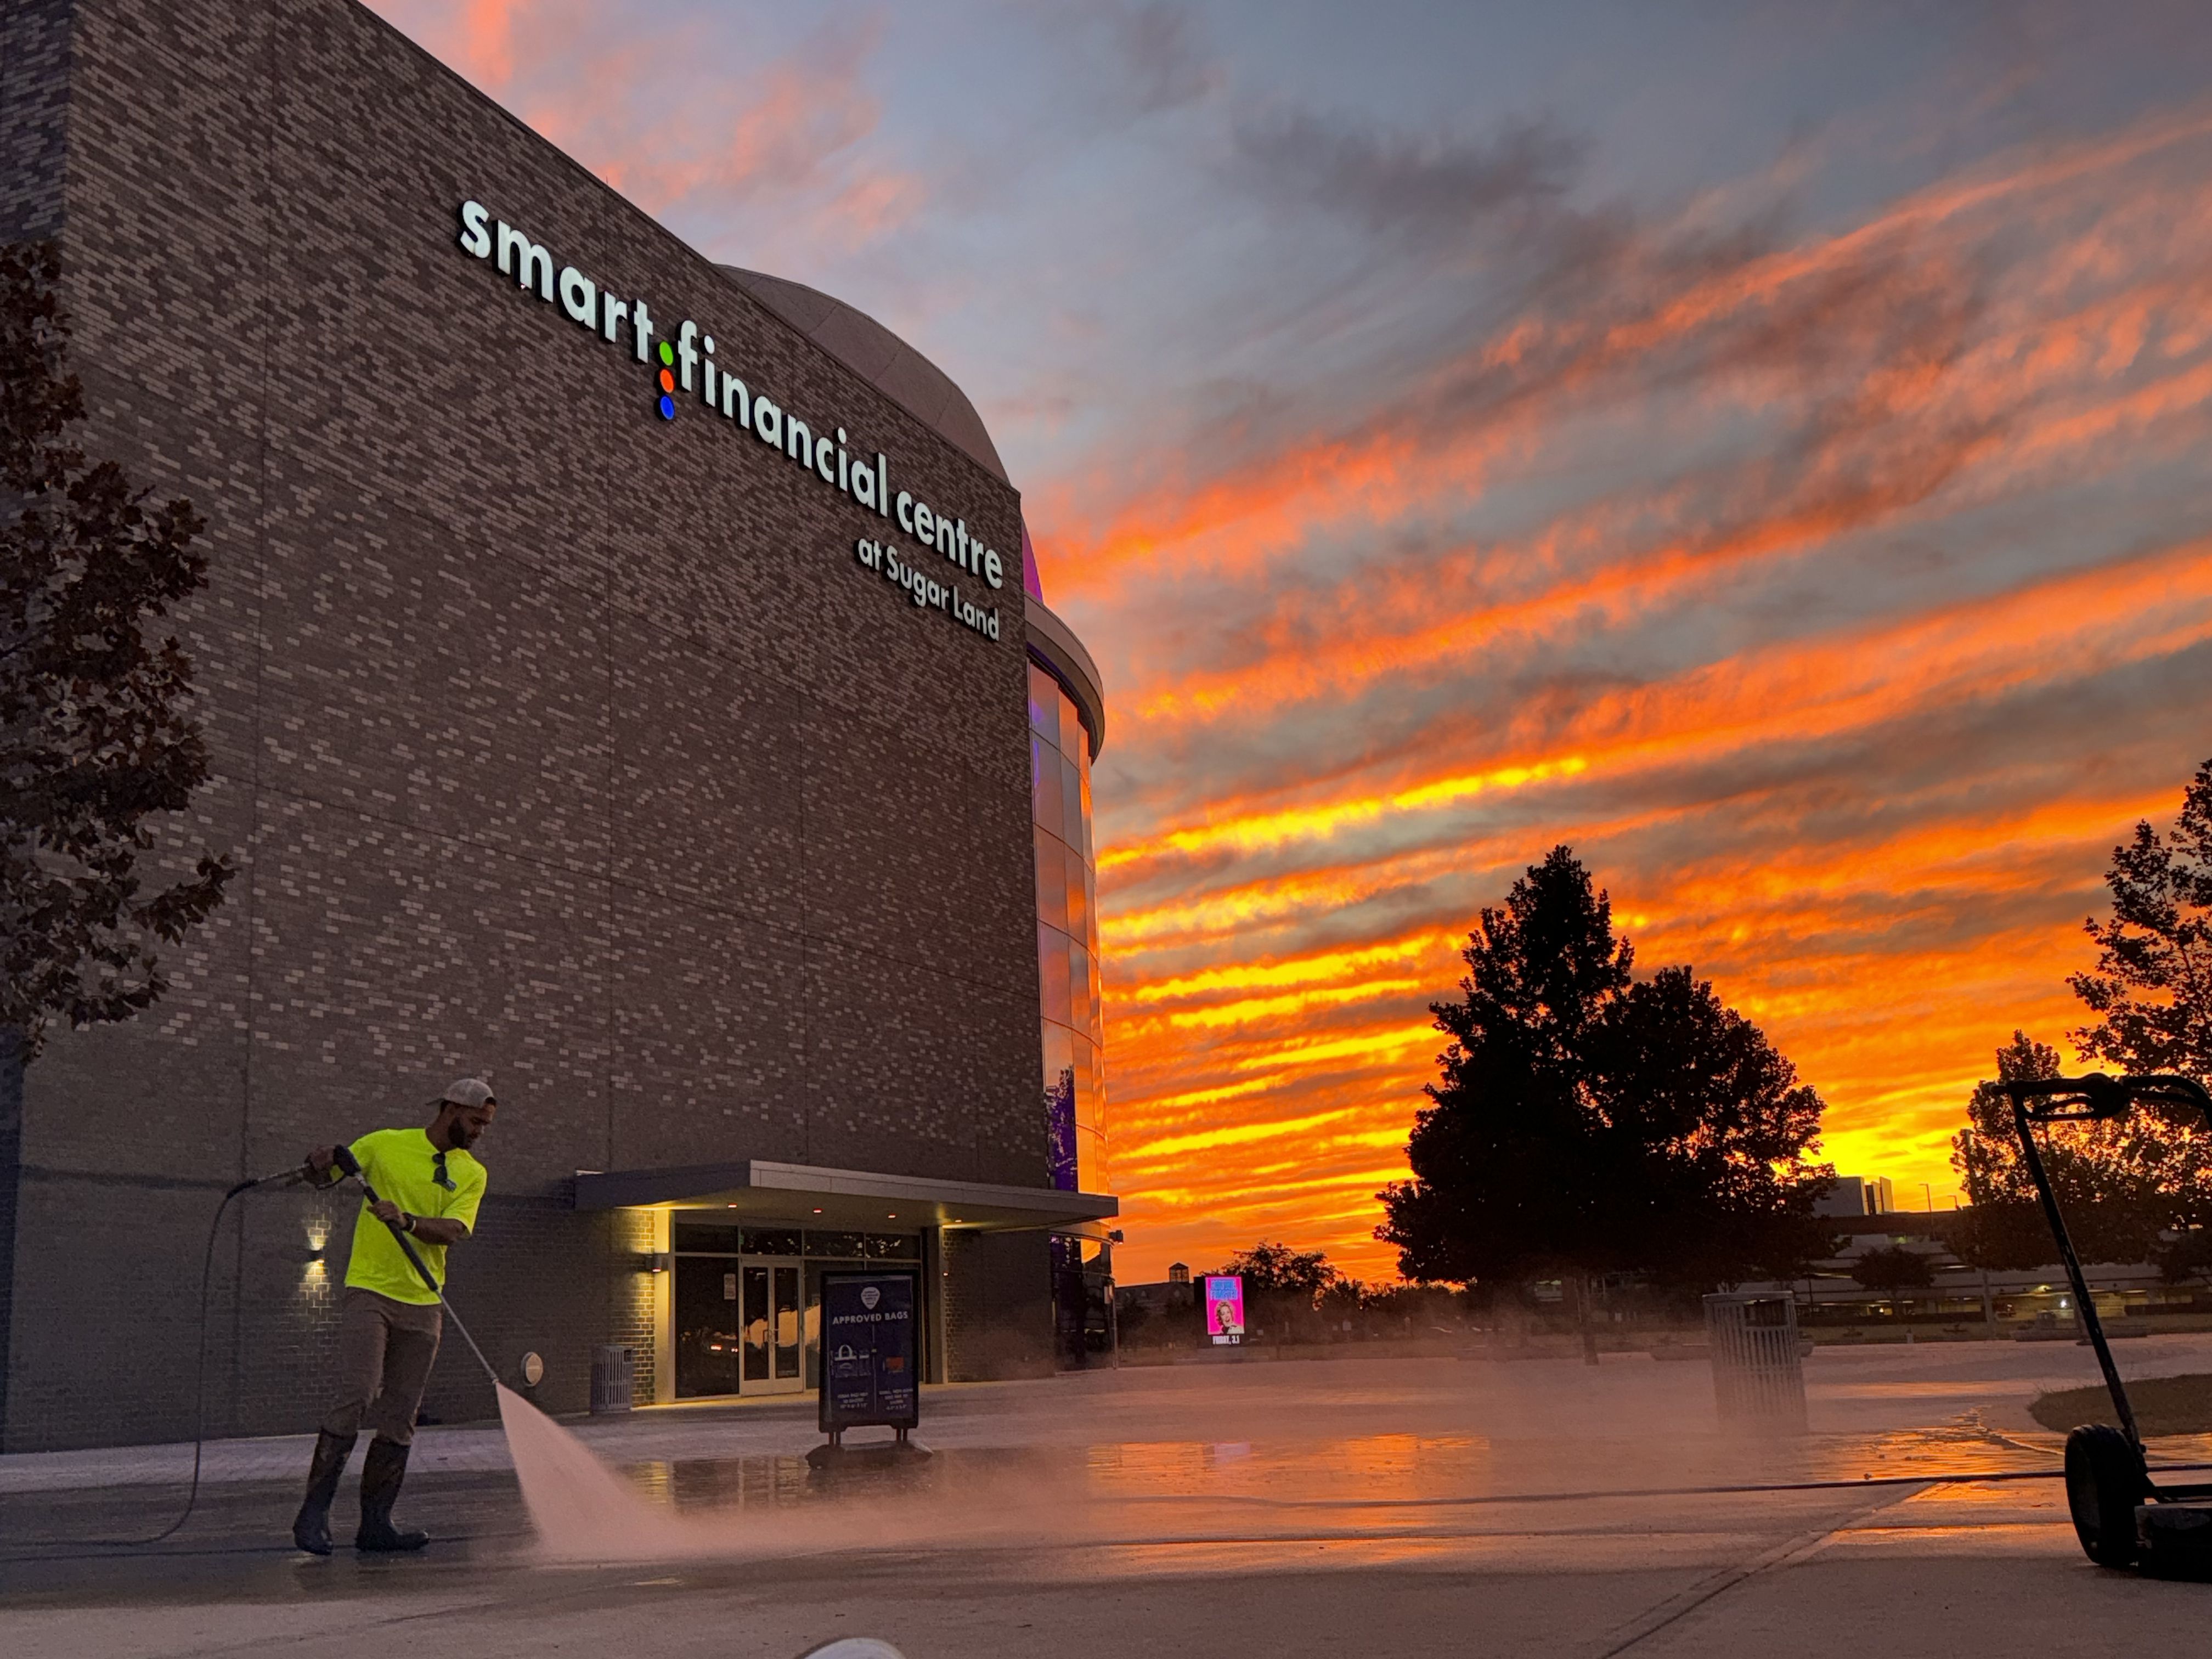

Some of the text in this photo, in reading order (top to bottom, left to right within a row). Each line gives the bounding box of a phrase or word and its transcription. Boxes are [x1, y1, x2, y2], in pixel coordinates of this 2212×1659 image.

[460, 200, 1003, 589] smart financial centre
[858, 538, 1000, 639] at Sugar Land
[832, 1311, 909, 1324] APPROVED BAGS
